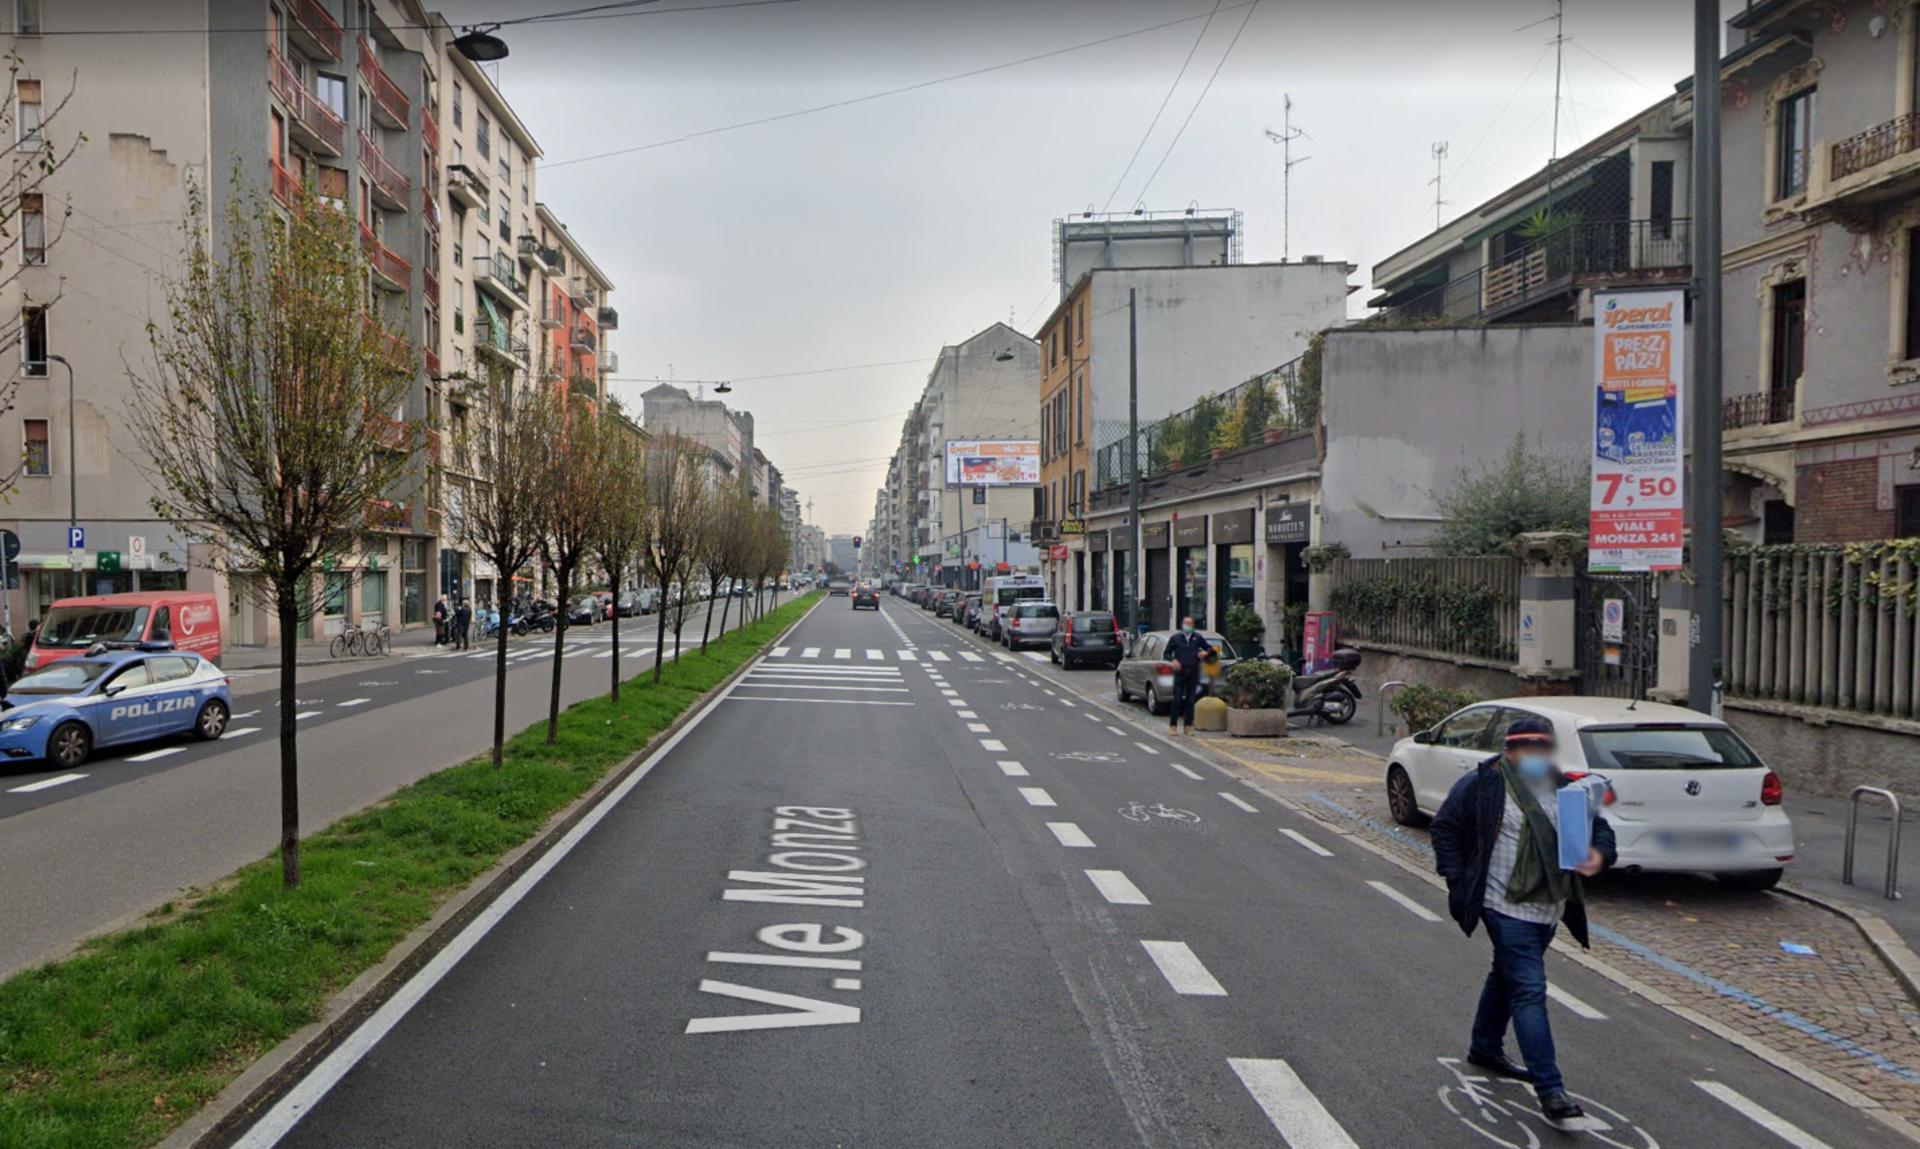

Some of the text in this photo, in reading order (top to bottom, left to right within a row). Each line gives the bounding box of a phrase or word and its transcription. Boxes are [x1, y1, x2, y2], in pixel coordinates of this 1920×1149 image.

[1603, 303, 1674, 328] iperal
[1614, 336, 1665, 353] PREZZI
[1615, 351, 1661, 371] PAZZI
[1614, 521, 1656, 531] VIALE
[72, 529, 82, 547] P
[1595, 532, 1676, 544] MONZA 241
[111, 696, 196, 720] POLIZIA
[684, 805, 867, 1035] V.le Monza
